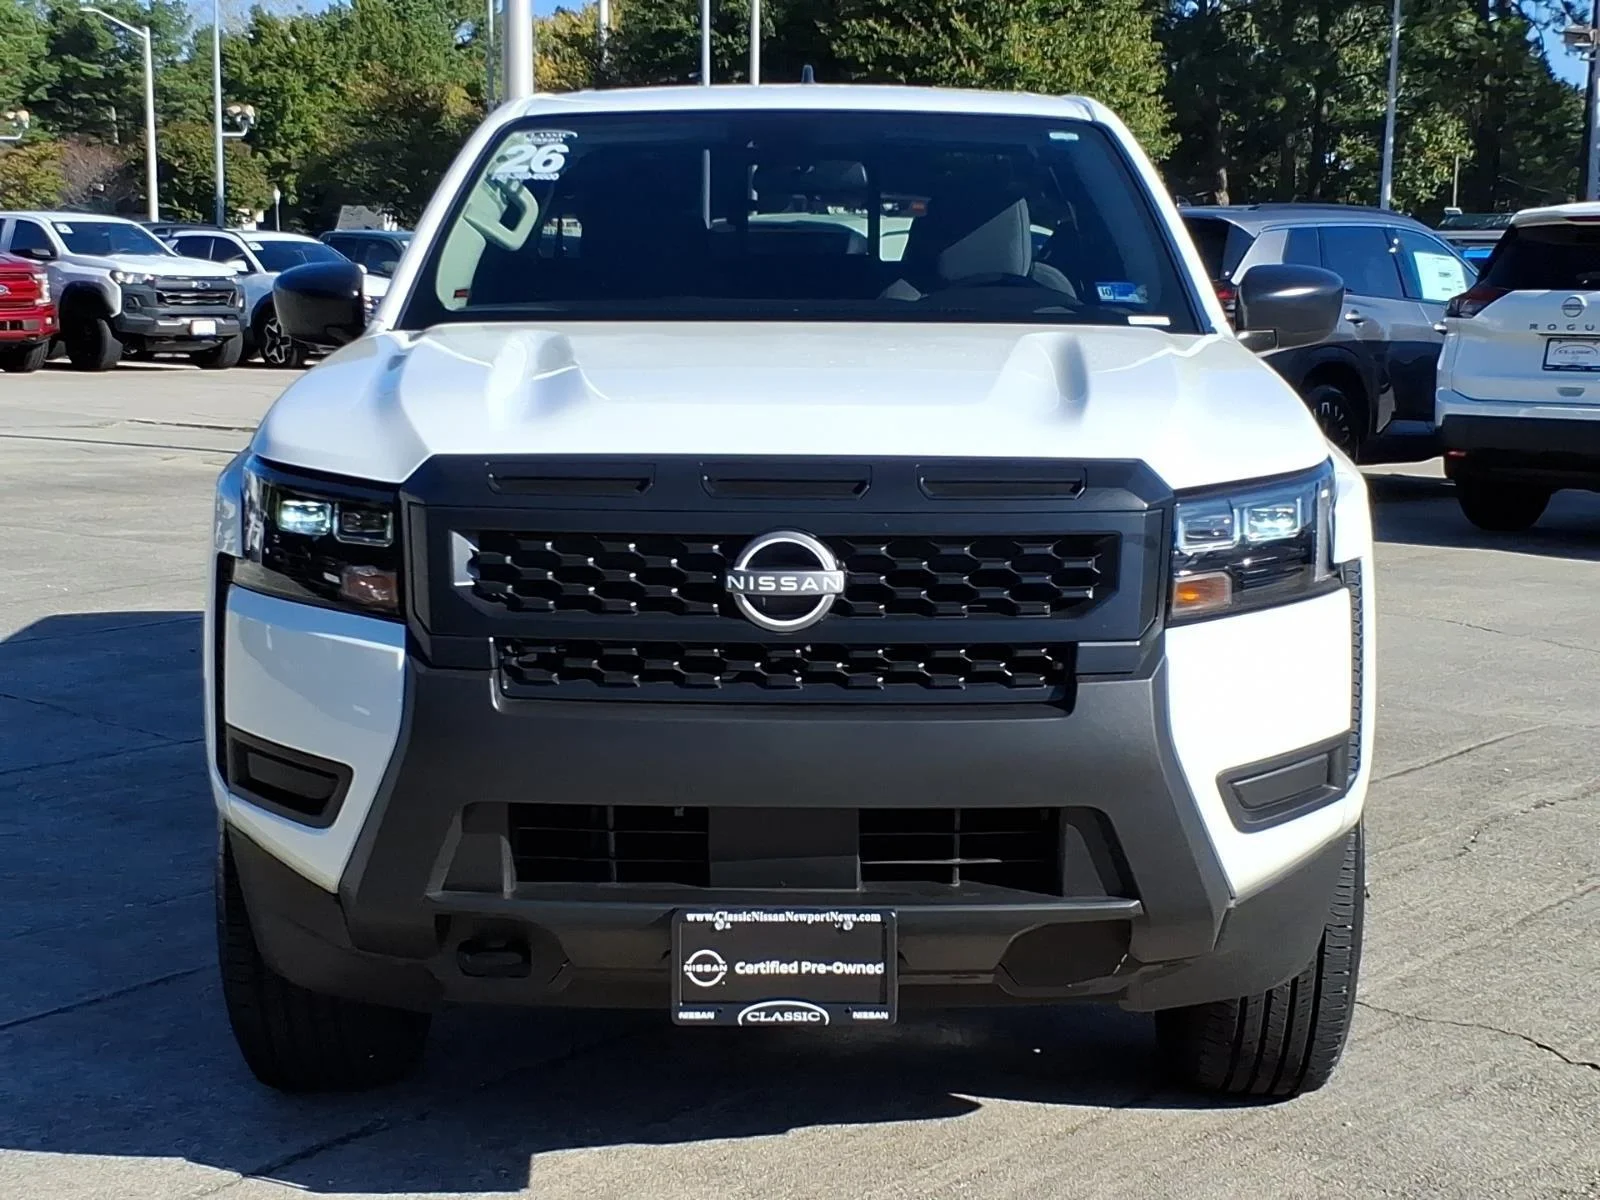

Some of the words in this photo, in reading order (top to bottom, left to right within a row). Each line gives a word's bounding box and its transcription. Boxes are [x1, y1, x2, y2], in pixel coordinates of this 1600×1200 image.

[495, 144, 569, 173] 26
[727, 575, 840, 591] NISSAN
[686, 911, 881, 924] www.ClassicNissanNewportNews.com
[683, 964, 728, 973] NISSAN
[735, 961, 798, 975] Certified
[801, 961, 884, 975] Pre-Owned
[679, 1011, 714, 1020] NISSAN
[747, 1011, 820, 1022] CLASSIC
[853, 1011, 888, 1020] NISSAN
